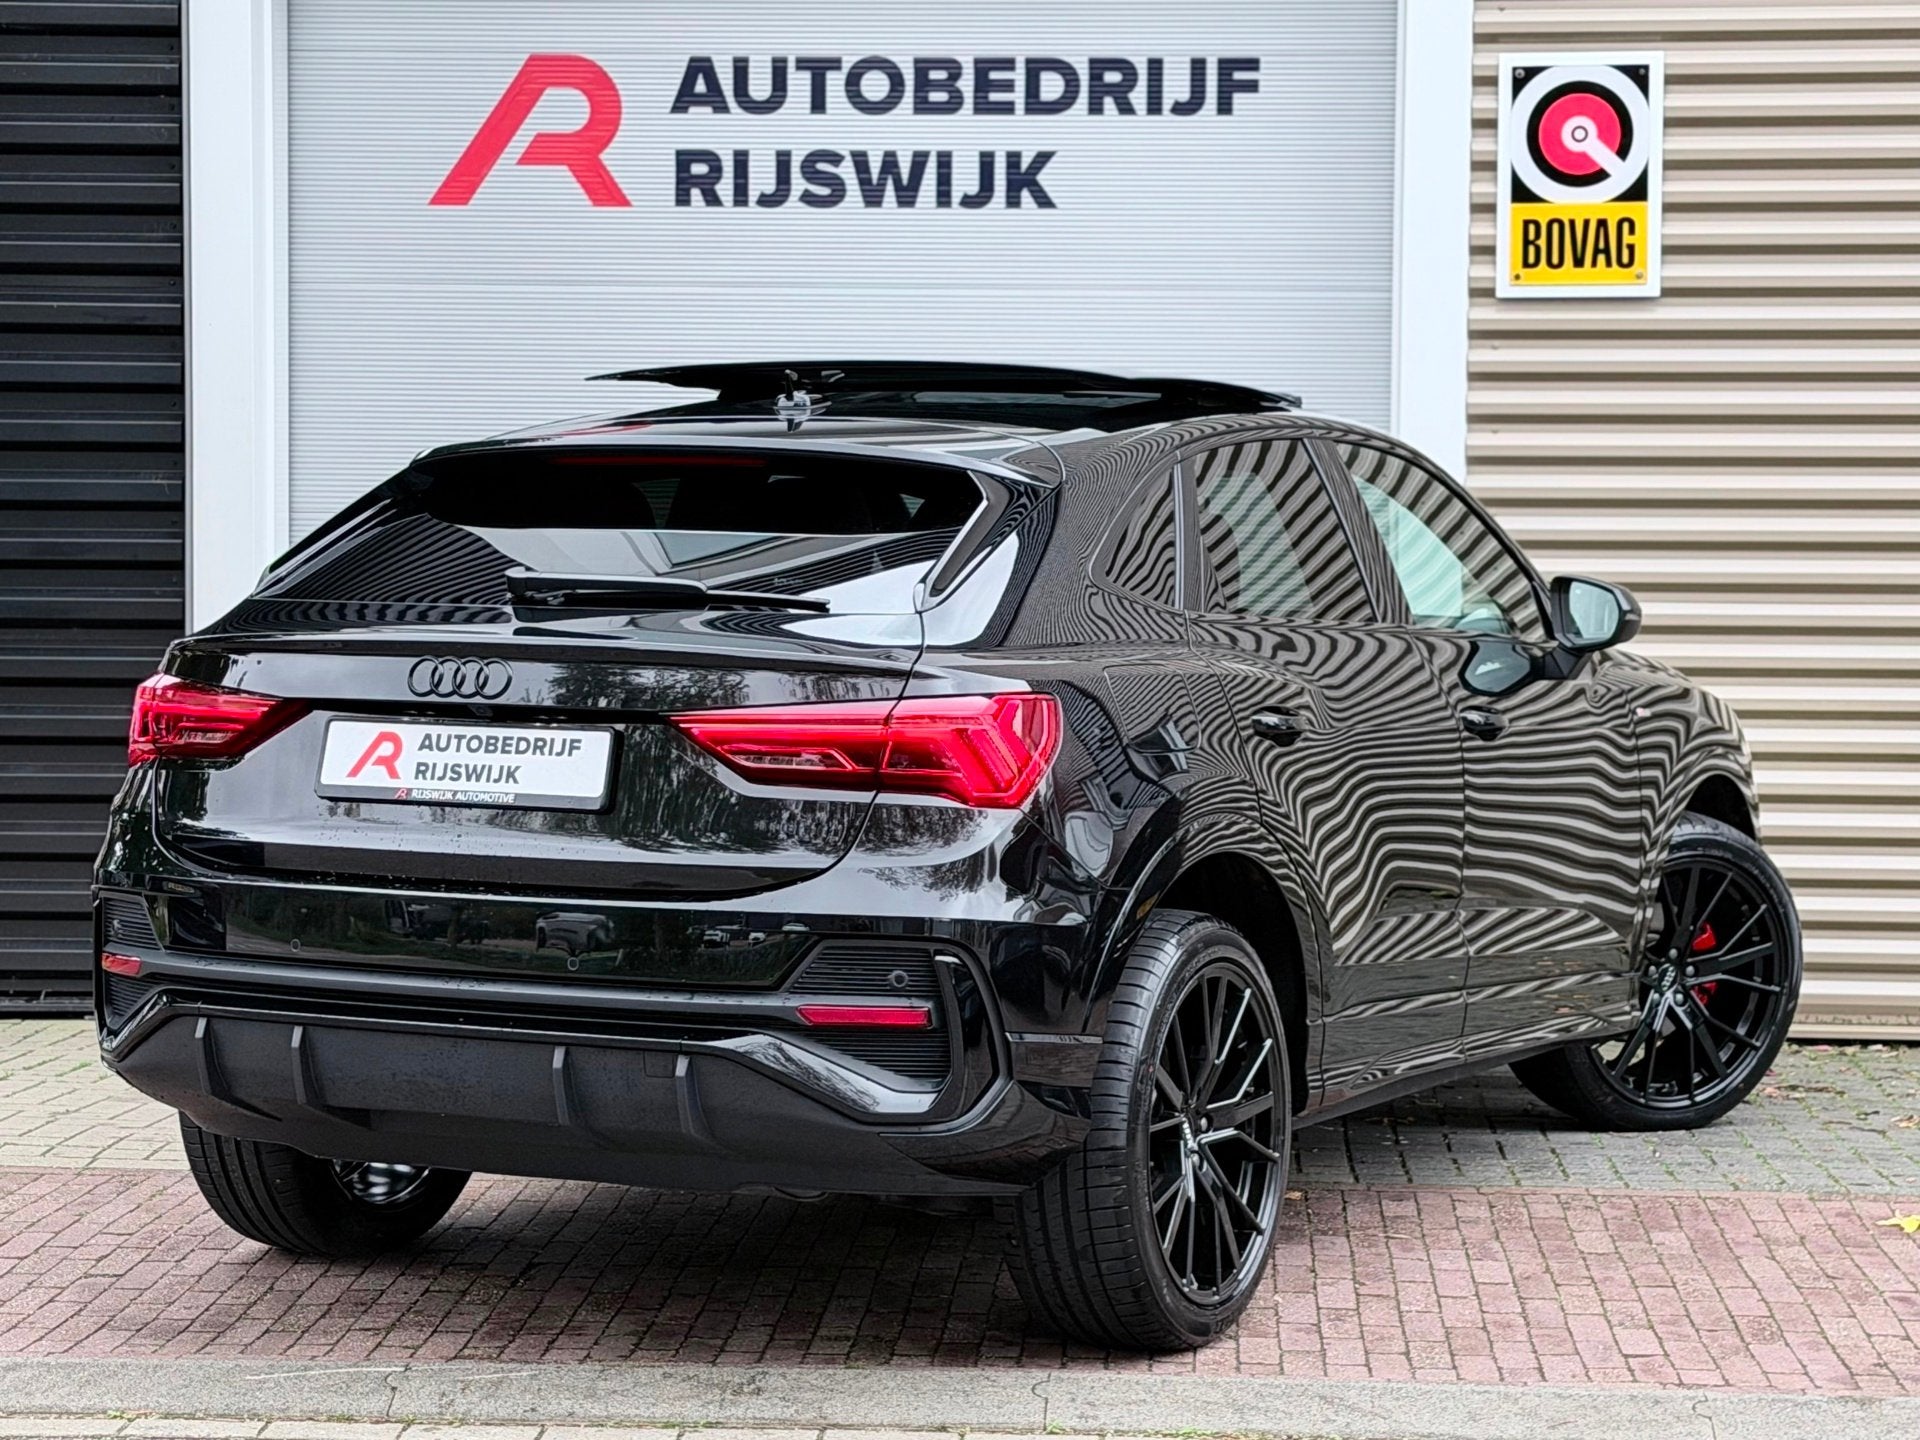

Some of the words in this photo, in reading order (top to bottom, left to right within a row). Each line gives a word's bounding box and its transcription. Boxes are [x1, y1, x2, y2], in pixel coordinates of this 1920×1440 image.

[671, 56, 1260, 116] AUTOBEDRIJF
[675, 149, 1057, 209] RIJSWIJK
[1522, 217, 1636, 269] BOVAG
[417, 733, 582, 757] AUTOBEDRIJF
[414, 762, 520, 784] RIJSWIJK
[411, 788, 453, 800] RIJSWIJK
[455, 791, 515, 803] AUTOMOTIVE
